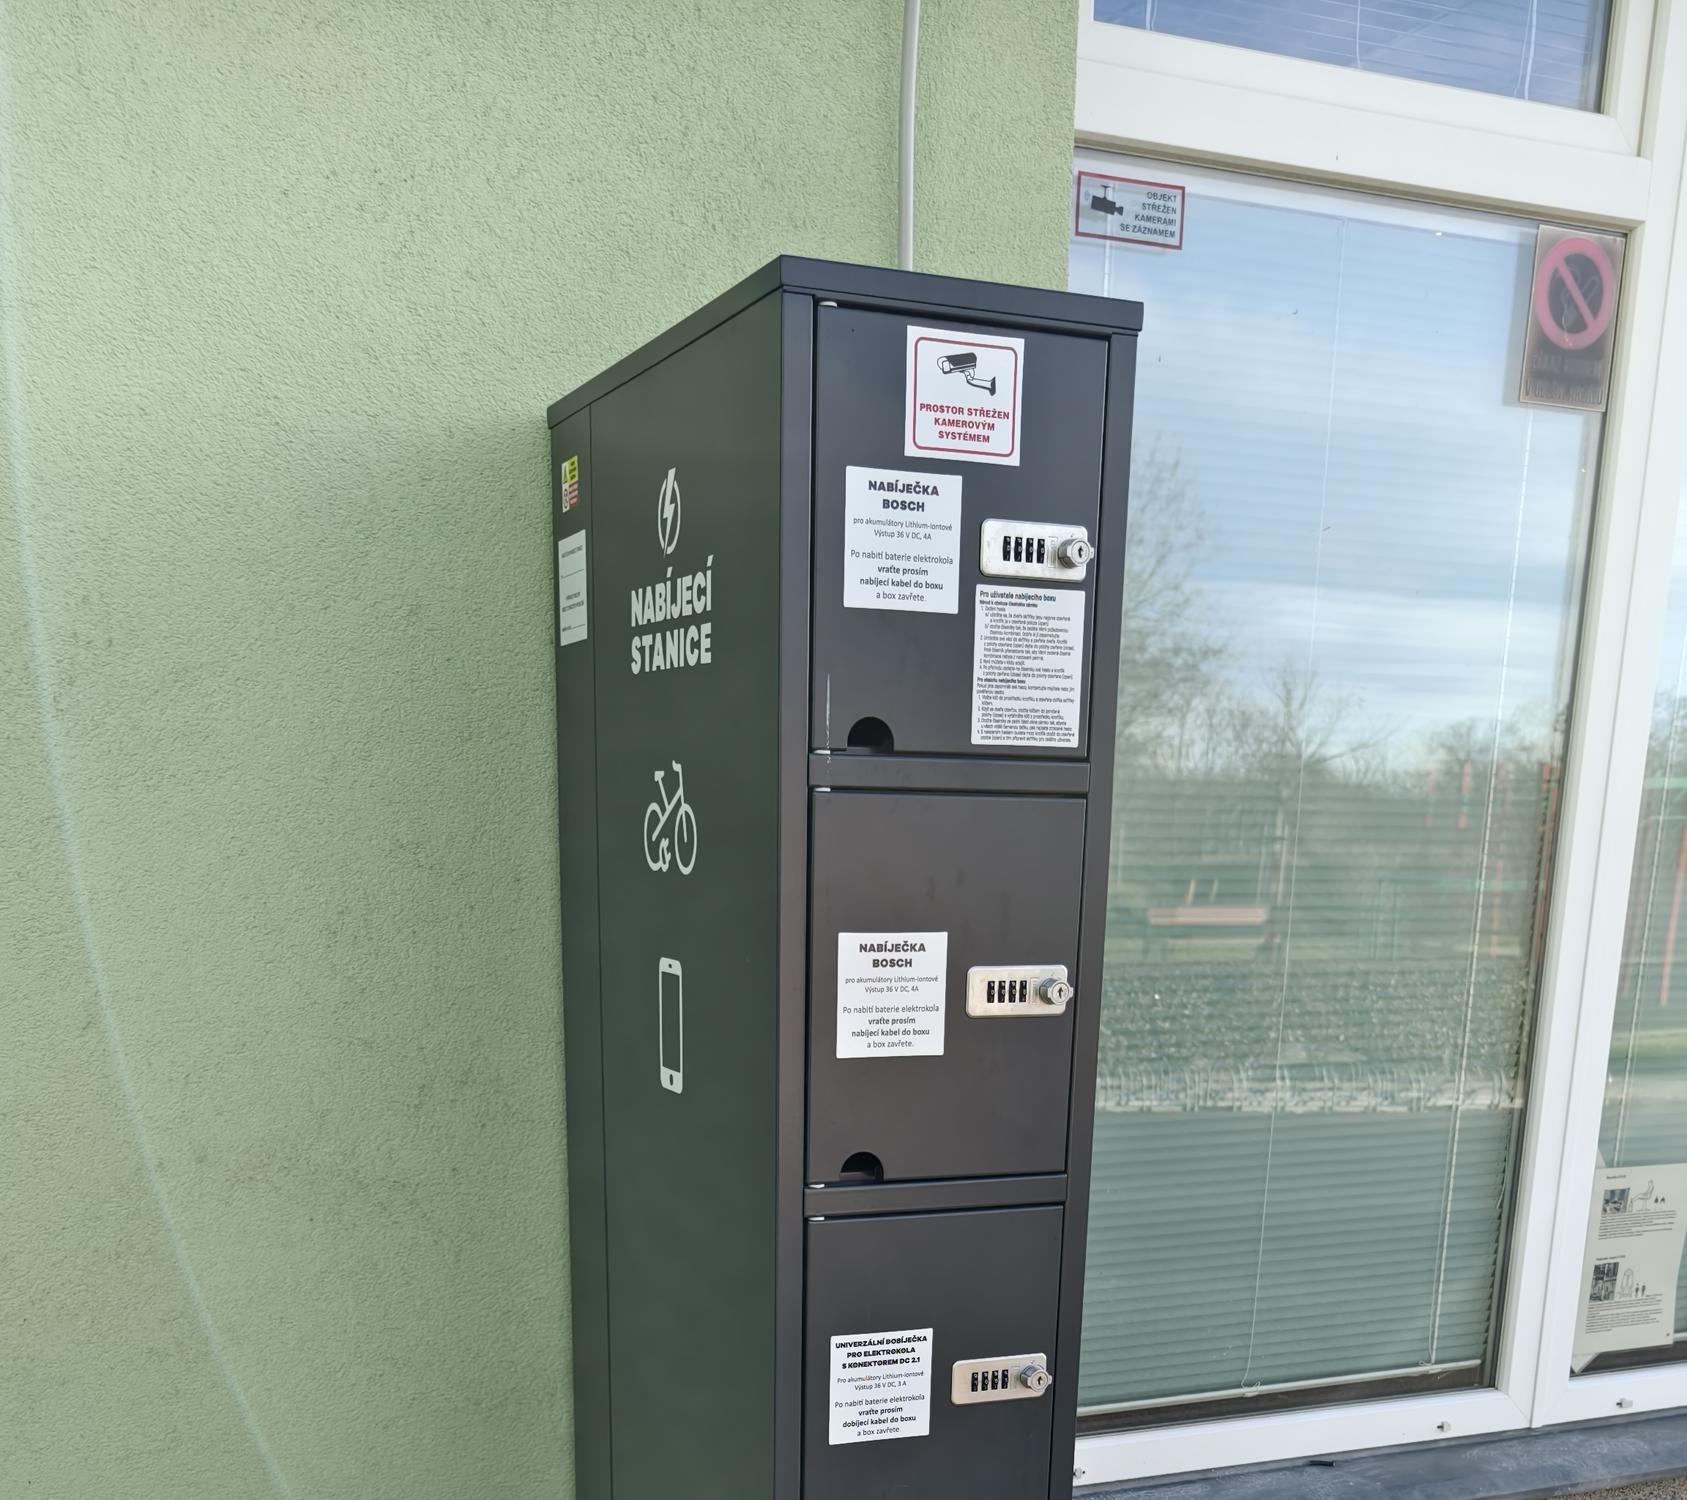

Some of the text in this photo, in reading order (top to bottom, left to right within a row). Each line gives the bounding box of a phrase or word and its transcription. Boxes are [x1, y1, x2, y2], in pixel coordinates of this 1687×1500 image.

[1147, 192, 1177, 202] OBJEKT
[1142, 202, 1177, 214] STŘEŽEN
[1135, 215, 1177, 226] KAMERAMI
[1132, 224, 1175, 238] ZÁZNAMEM
[920, 403, 1009, 420] PROSTOR STŘEŽEN
[934, 417, 995, 431] KAMEROVÝM
[938, 430, 990, 443] SYSTÉMEM
[869, 479, 939, 496] NABÍJEČKA
[883, 499, 925, 512] BOSCH
[865, 517, 904, 528] akumulátory
[874, 529, 895, 538] Výstup
[911, 532, 922, 540] DC,
[851, 549, 953, 564] Po nabití baterie elektrokola
[878, 564, 928, 576] vraťte prosím
[860, 577, 943, 590] nabíjecí kabel do boxu
[631, 554, 714, 627] NABÍJECÍ
[883, 591, 896, 599] box
[631, 622, 712, 675] STANICE
[859, 940, 926, 952] NABÍJEČKA
[872, 958, 912, 968] BOSCH
[856, 976, 893, 984] akumulátory
[865, 986, 885, 994] Výstup
[843, 1004, 939, 1014] Po nabití baterie elektrokola
[868, 1016, 916, 1026] vraťte prosím
[852, 1029, 879, 1038] nabíjecí
[881, 1028, 900, 1036] kabel
[902, 1028, 911, 1036] do
[836, 1338, 885, 1349] UNIVERZÁLNÍ
[863, 1347, 916, 1357] ELEKTROKOLA
[848, 1359, 898, 1368] KONEKTOREM
[845, 1399, 863, 1407] nabití
[889, 1394, 925, 1403] elektrokola
[858, 1406, 903, 1416] vraťte prosím
[843, 1419, 869, 1428] dobíjecí
[871, 1417, 888, 1425] kabel
